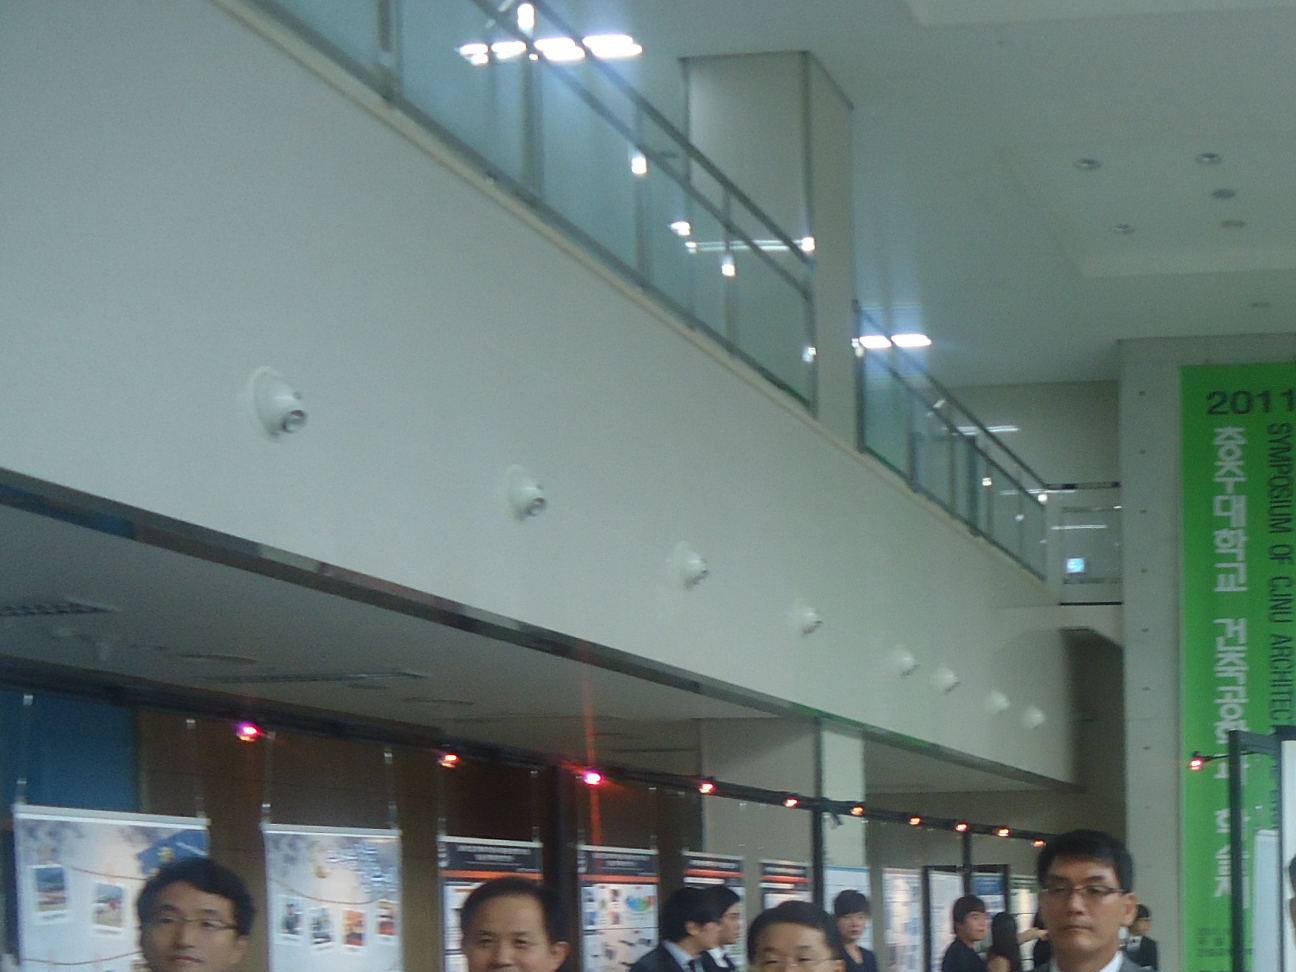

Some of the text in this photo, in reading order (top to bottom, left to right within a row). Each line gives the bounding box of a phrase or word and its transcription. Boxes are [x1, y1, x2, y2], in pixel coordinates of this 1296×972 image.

[1206, 389, 1296, 415] 2011
[1212, 426, 1248, 592] 충주대학교
[1267, 422, 1294, 534] SYMPOSIUM
[1268, 544, 1293, 565] OF
[1269, 576, 1294, 623] CJNU
[1269, 633, 1295, 728] ARCHITEC
